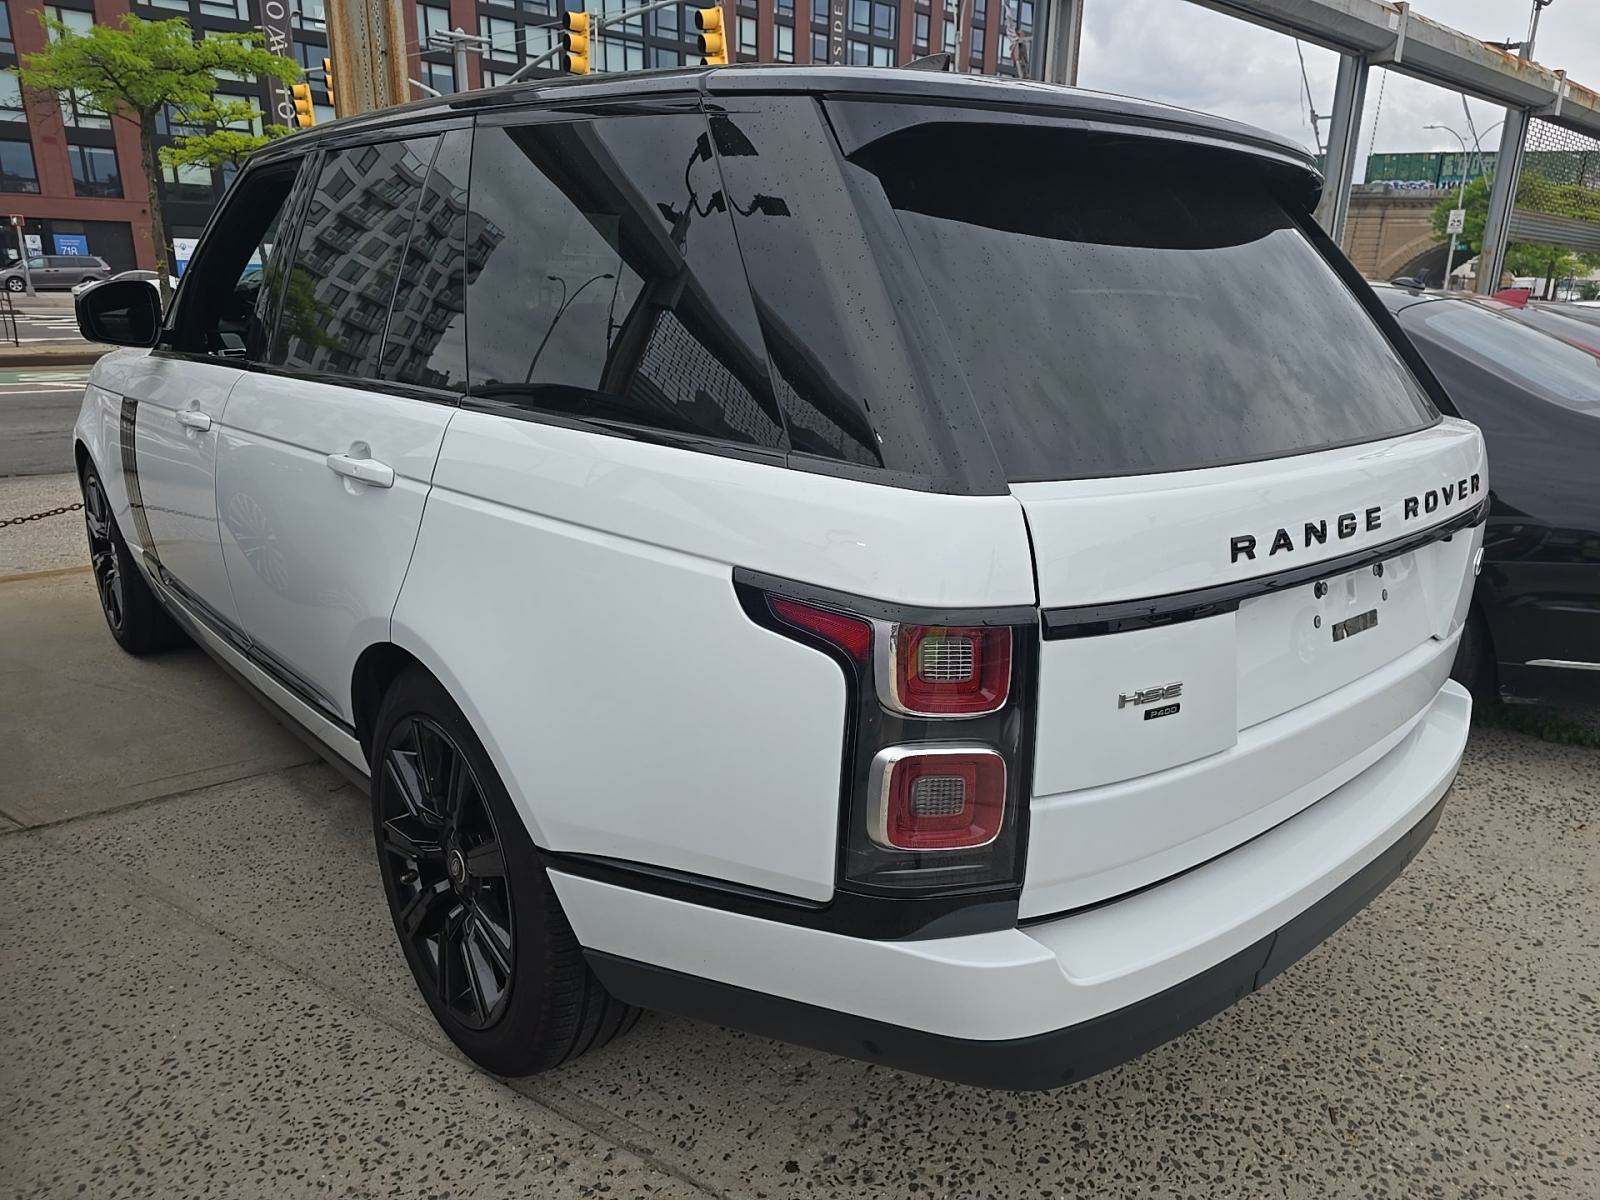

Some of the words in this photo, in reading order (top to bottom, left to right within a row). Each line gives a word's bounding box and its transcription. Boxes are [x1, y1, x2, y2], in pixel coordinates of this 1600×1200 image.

[1230, 506, 1382, 563] RANGE
[1404, 473, 1480, 520] ROVER
[1118, 681, 1183, 709] HSE
[1150, 706, 1177, 718] P400
